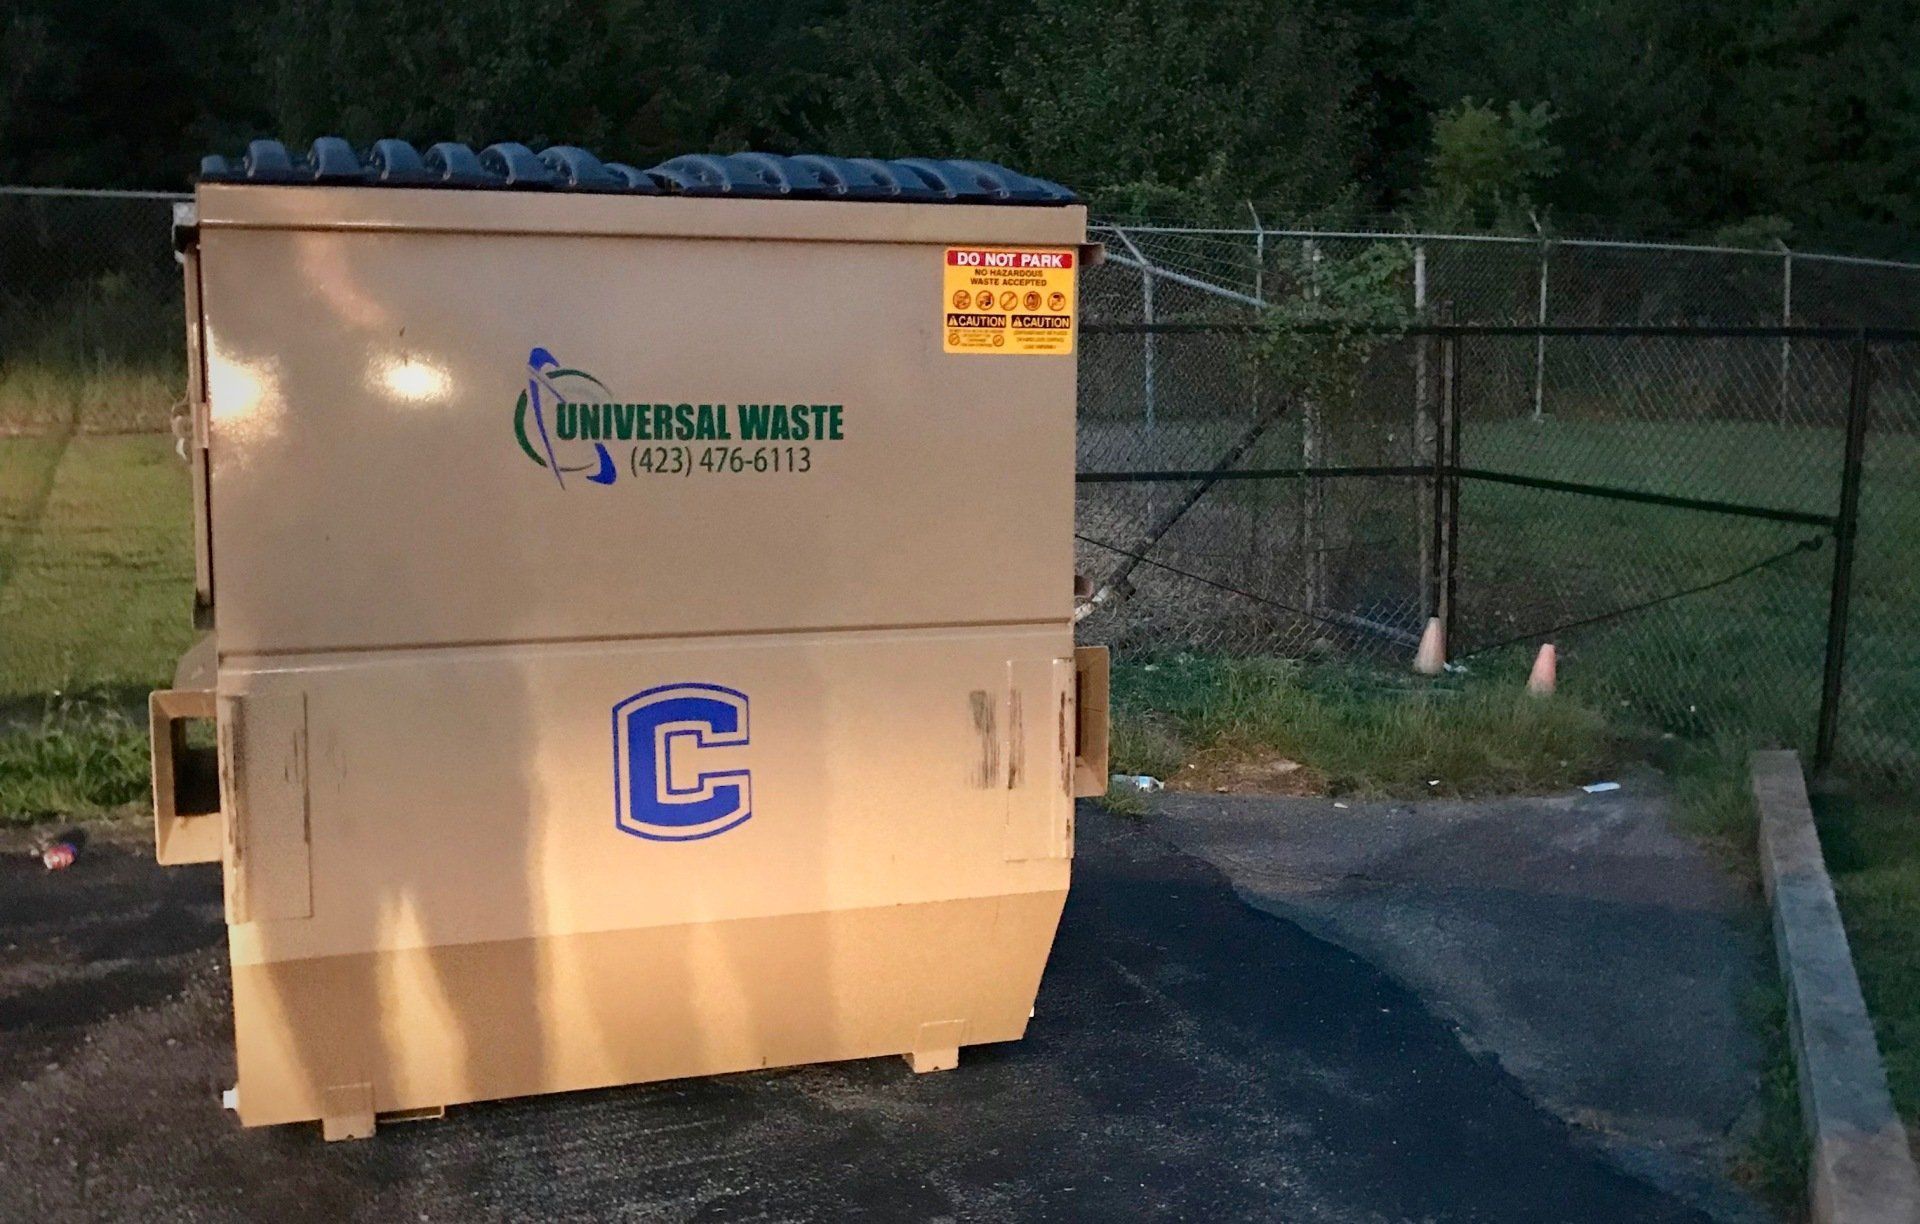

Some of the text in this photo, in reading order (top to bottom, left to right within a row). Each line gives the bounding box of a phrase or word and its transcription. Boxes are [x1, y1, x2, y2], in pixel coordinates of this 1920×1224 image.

[957, 252, 1062, 267] DO NOT PARK
[990, 269, 1043, 277] HAZARDOUS
[970, 278, 999, 286] WASTE
[959, 315, 1005, 327] CAUTION
[1023, 316, 1069, 328] CAUTION
[556, 403, 844, 440] UNIVERSAL WASTE
[631, 446, 811, 477] (423) 476-6113
[612, 682, 752, 842] C
